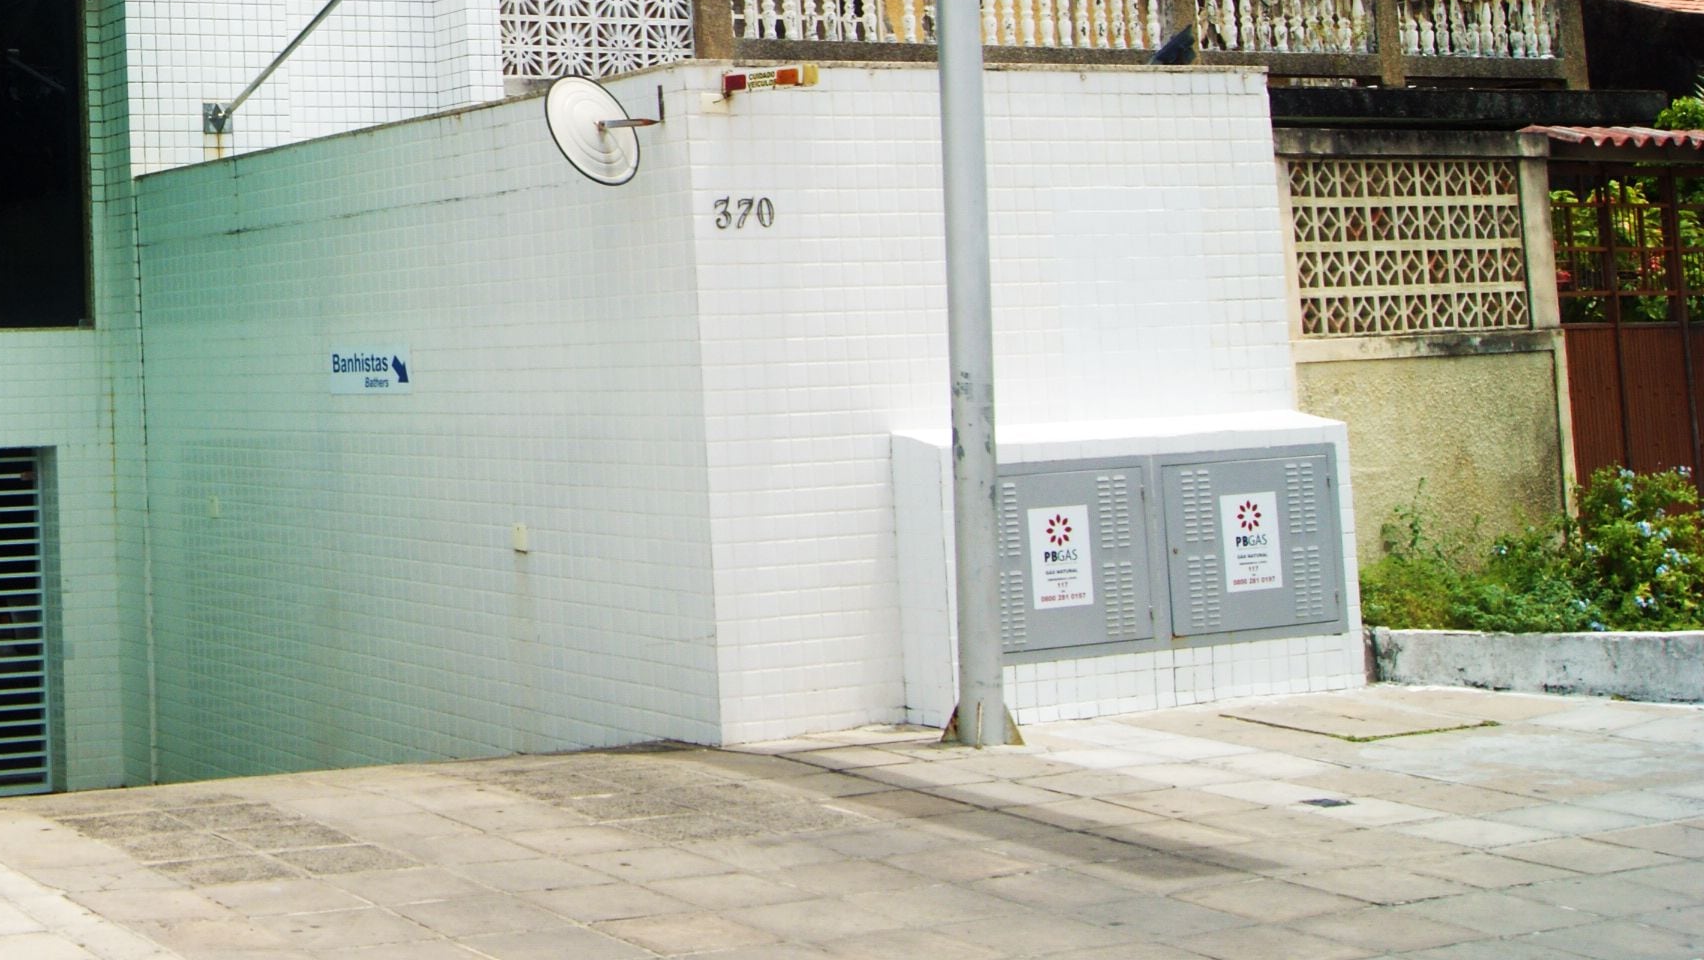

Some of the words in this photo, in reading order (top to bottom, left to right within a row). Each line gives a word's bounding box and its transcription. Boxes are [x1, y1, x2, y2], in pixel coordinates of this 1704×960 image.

[748, 71, 775, 81] CUIDADO
[714, 196, 775, 229] 370
[332, 353, 389, 373] Banhistas
[364, 377, 389, 388] Bathers
